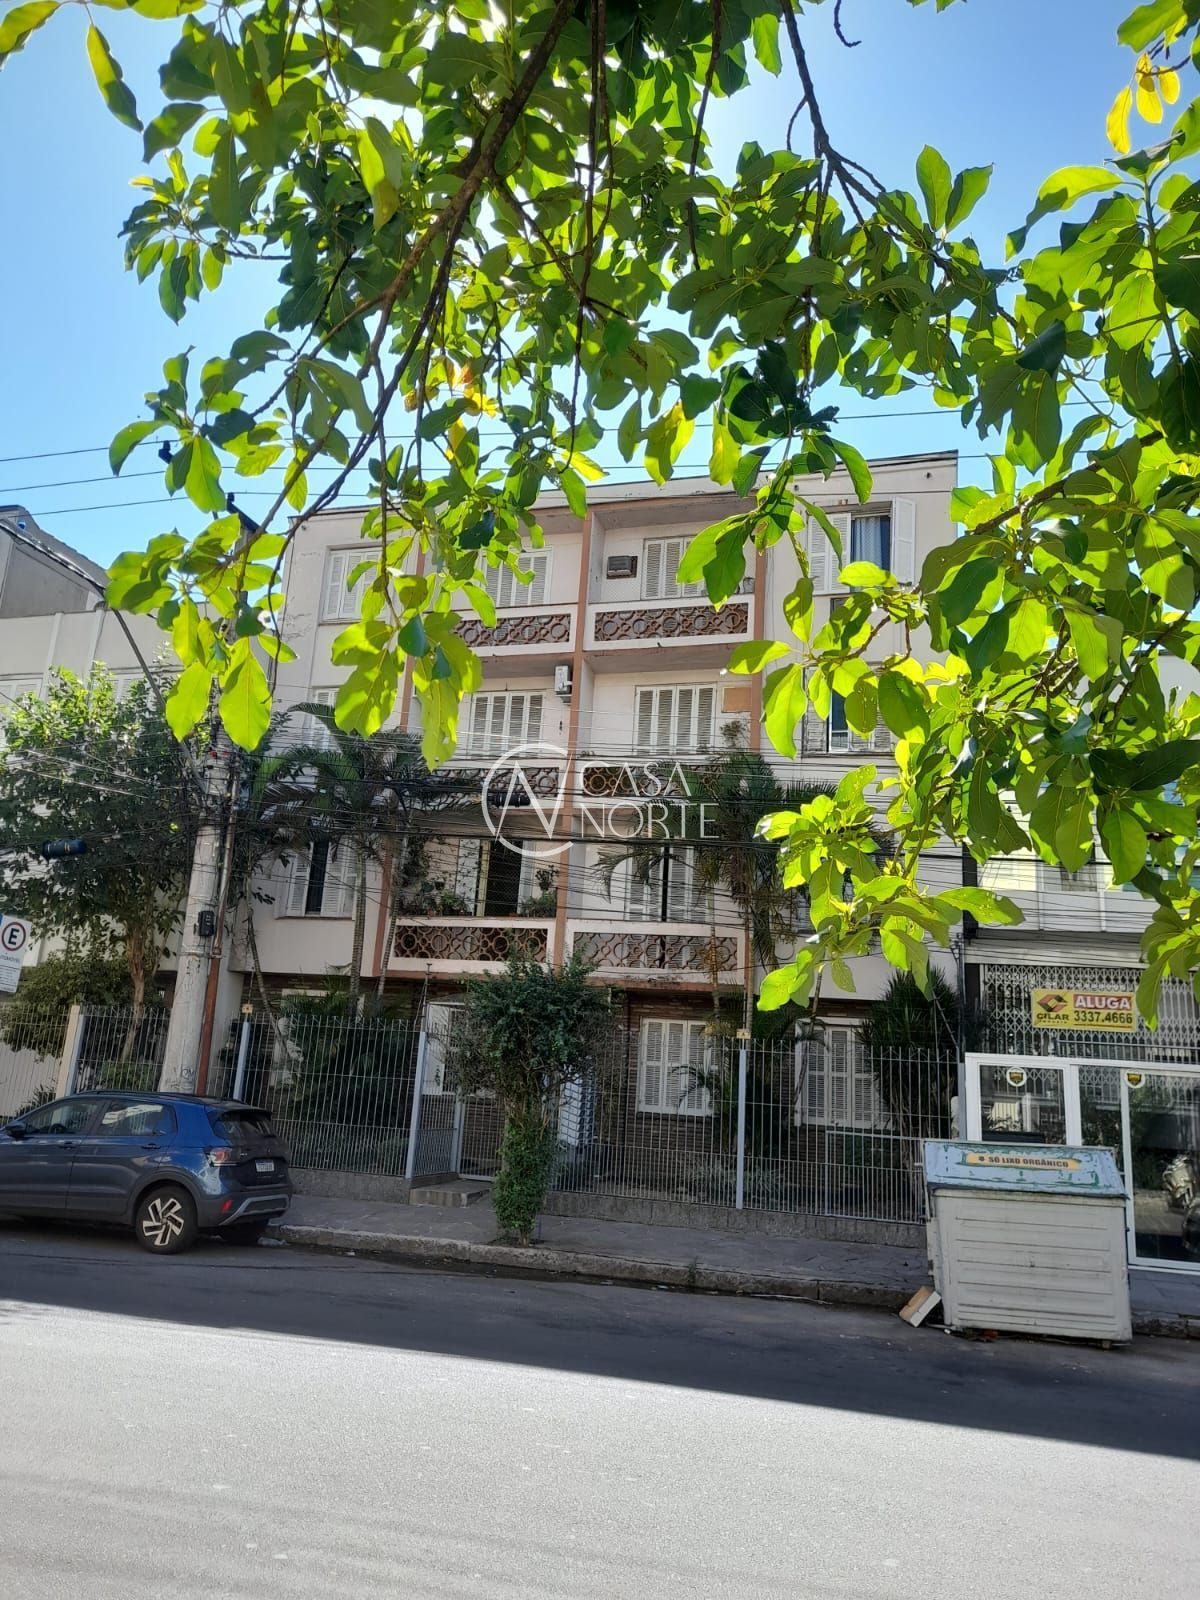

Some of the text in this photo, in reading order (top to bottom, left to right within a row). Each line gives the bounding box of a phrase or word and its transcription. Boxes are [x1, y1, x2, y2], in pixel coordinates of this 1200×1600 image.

[8, 928, 20, 946] E
[1075, 995, 1131, 1009] ALUGA
[1073, 1010, 1133, 1024] 3337.4666
[1002, 1156, 1021, 1165] LIXO
